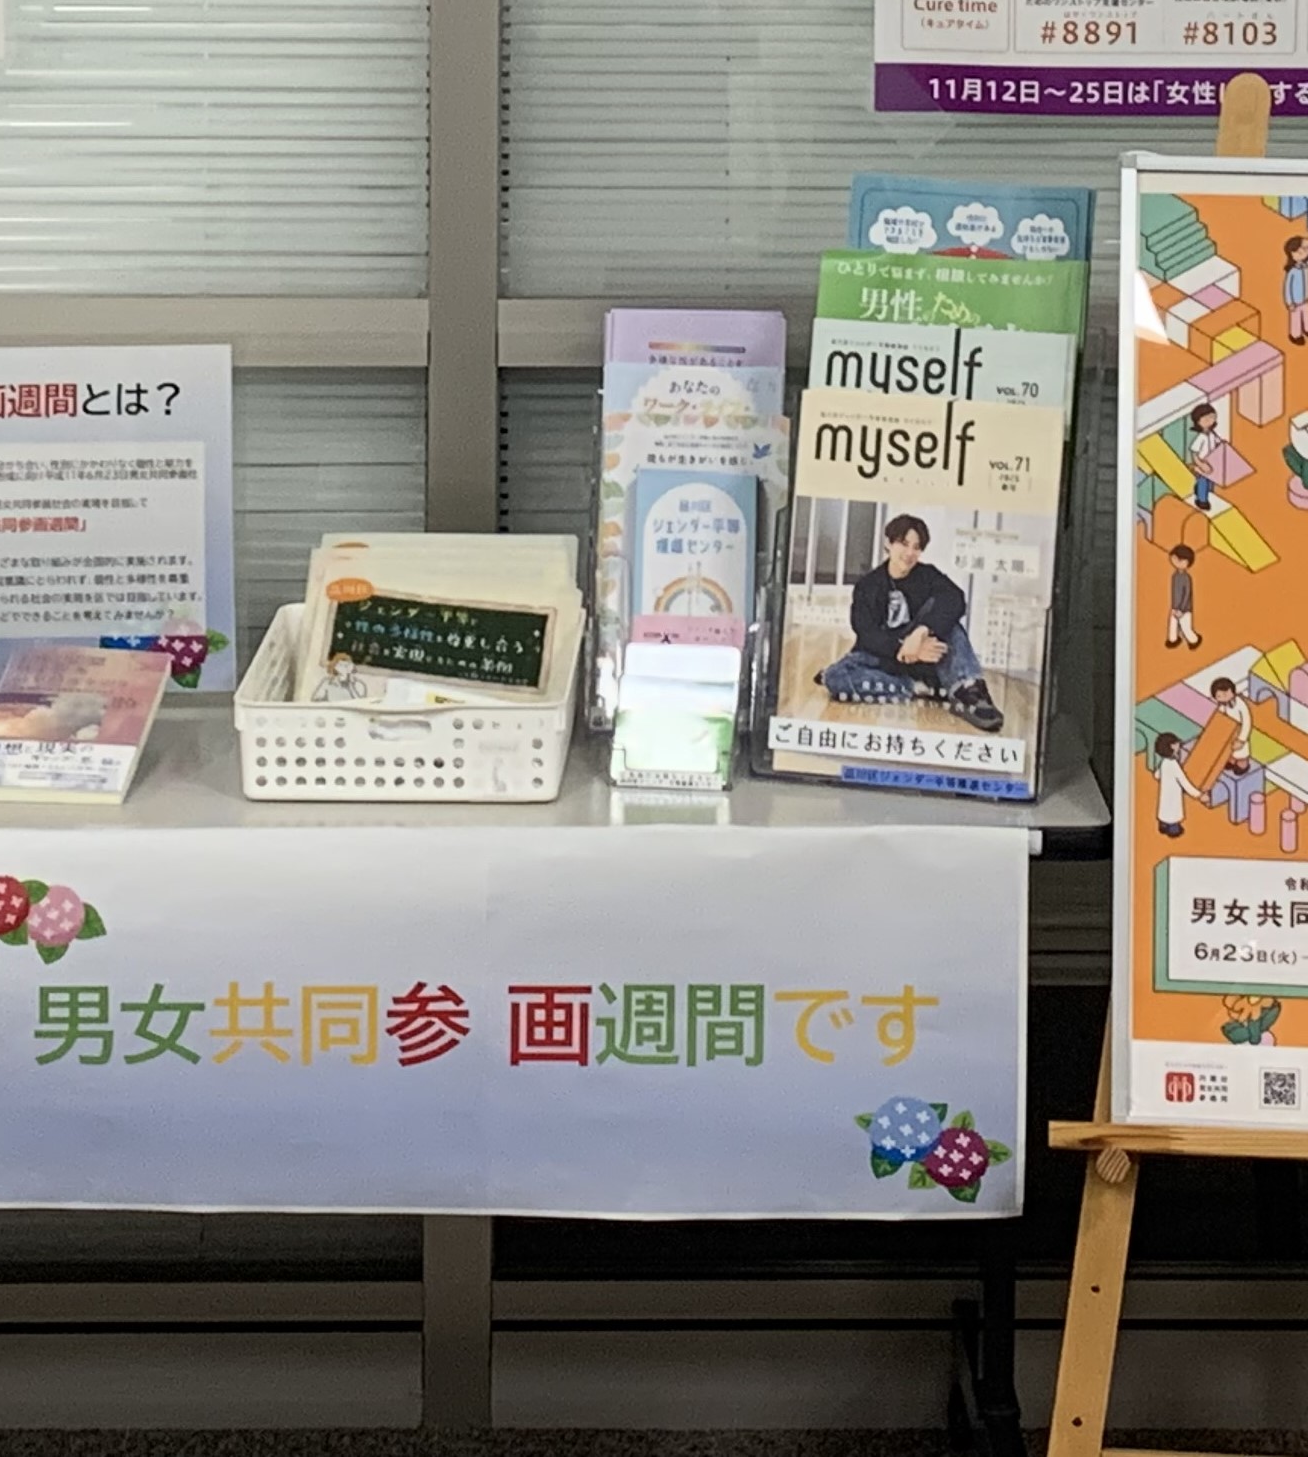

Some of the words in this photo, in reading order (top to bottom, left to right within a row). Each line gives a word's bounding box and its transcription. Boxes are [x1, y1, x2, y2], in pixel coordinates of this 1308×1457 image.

[1041, 21, 1139, 45] #8891
[1183, 21, 1278, 45] #8103
[825, 328, 983, 400] myself
[669, 380, 720, 395] あなたの
[815, 401, 975, 486] myself
[774, 723, 1018, 763] ご自由にお持ちください
